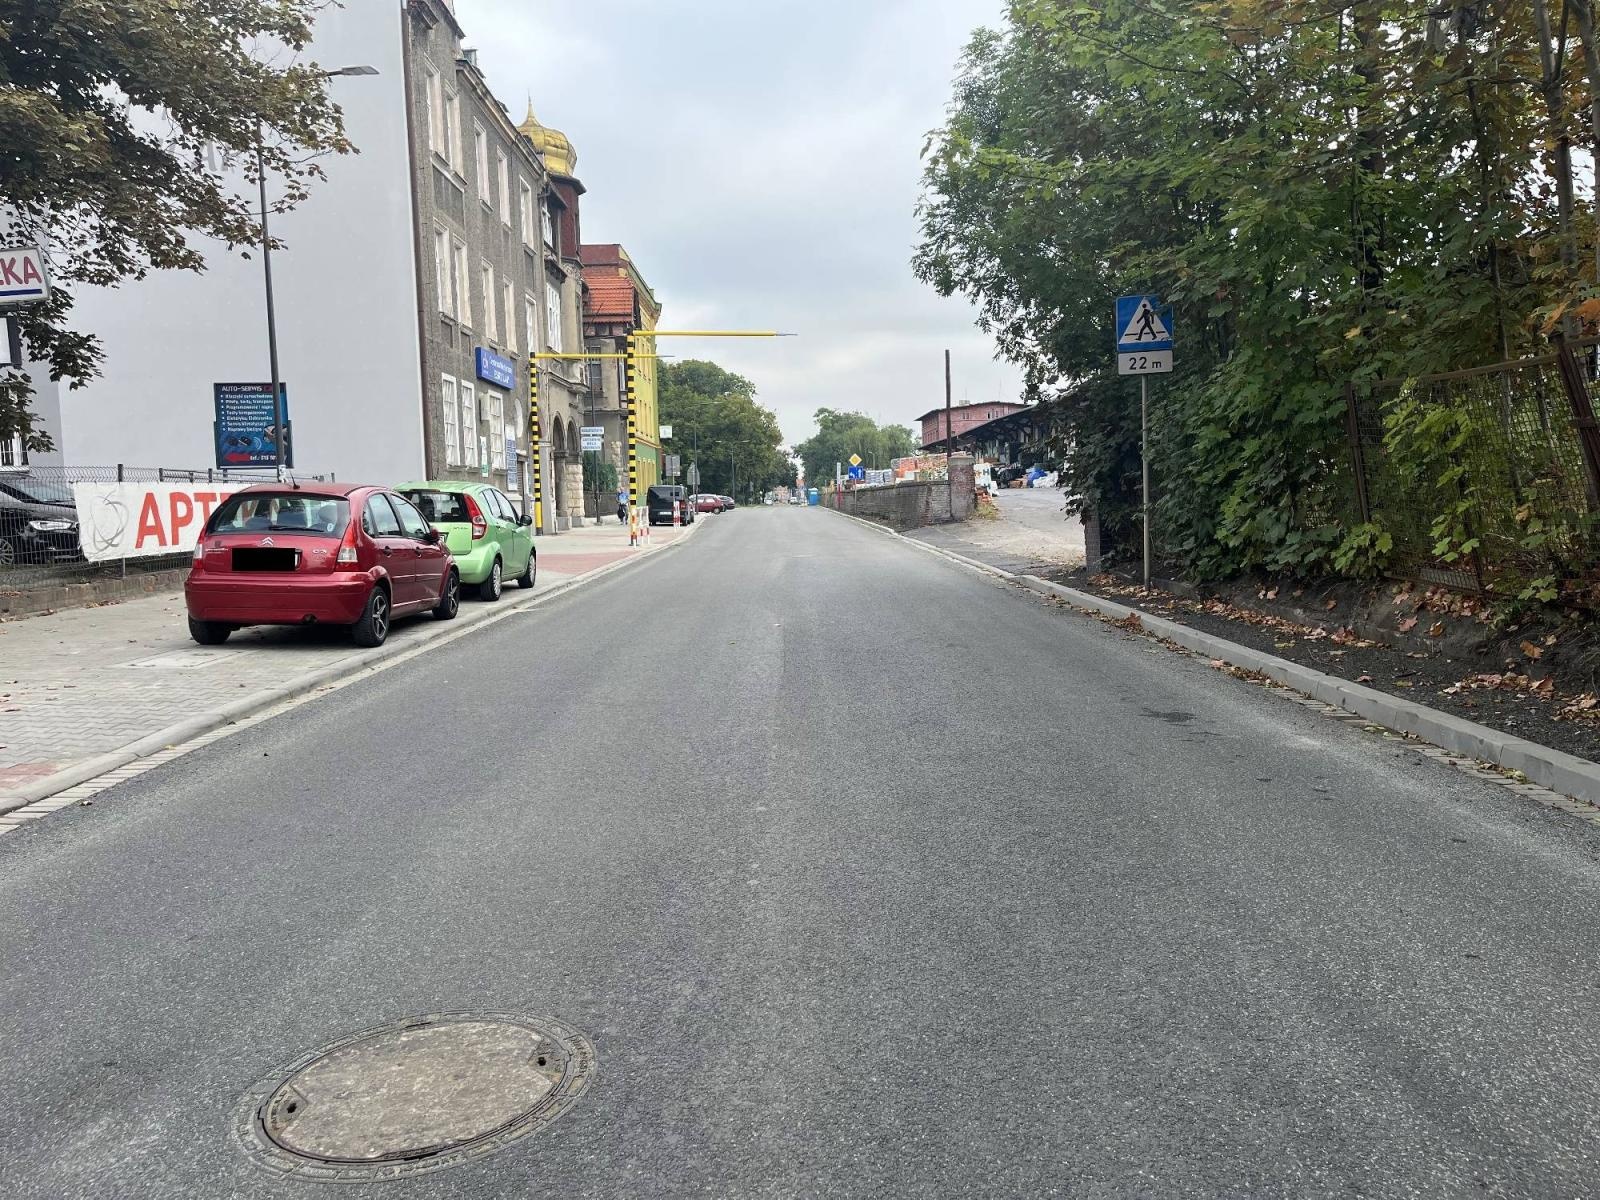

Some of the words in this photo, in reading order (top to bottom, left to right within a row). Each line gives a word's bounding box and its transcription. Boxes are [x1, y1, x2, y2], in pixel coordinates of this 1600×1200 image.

[0, 256, 42, 285] KA
[1129, 357, 1147, 370] 22
[1152, 361, 1162, 369] m
[135, 491, 232, 548] APT
